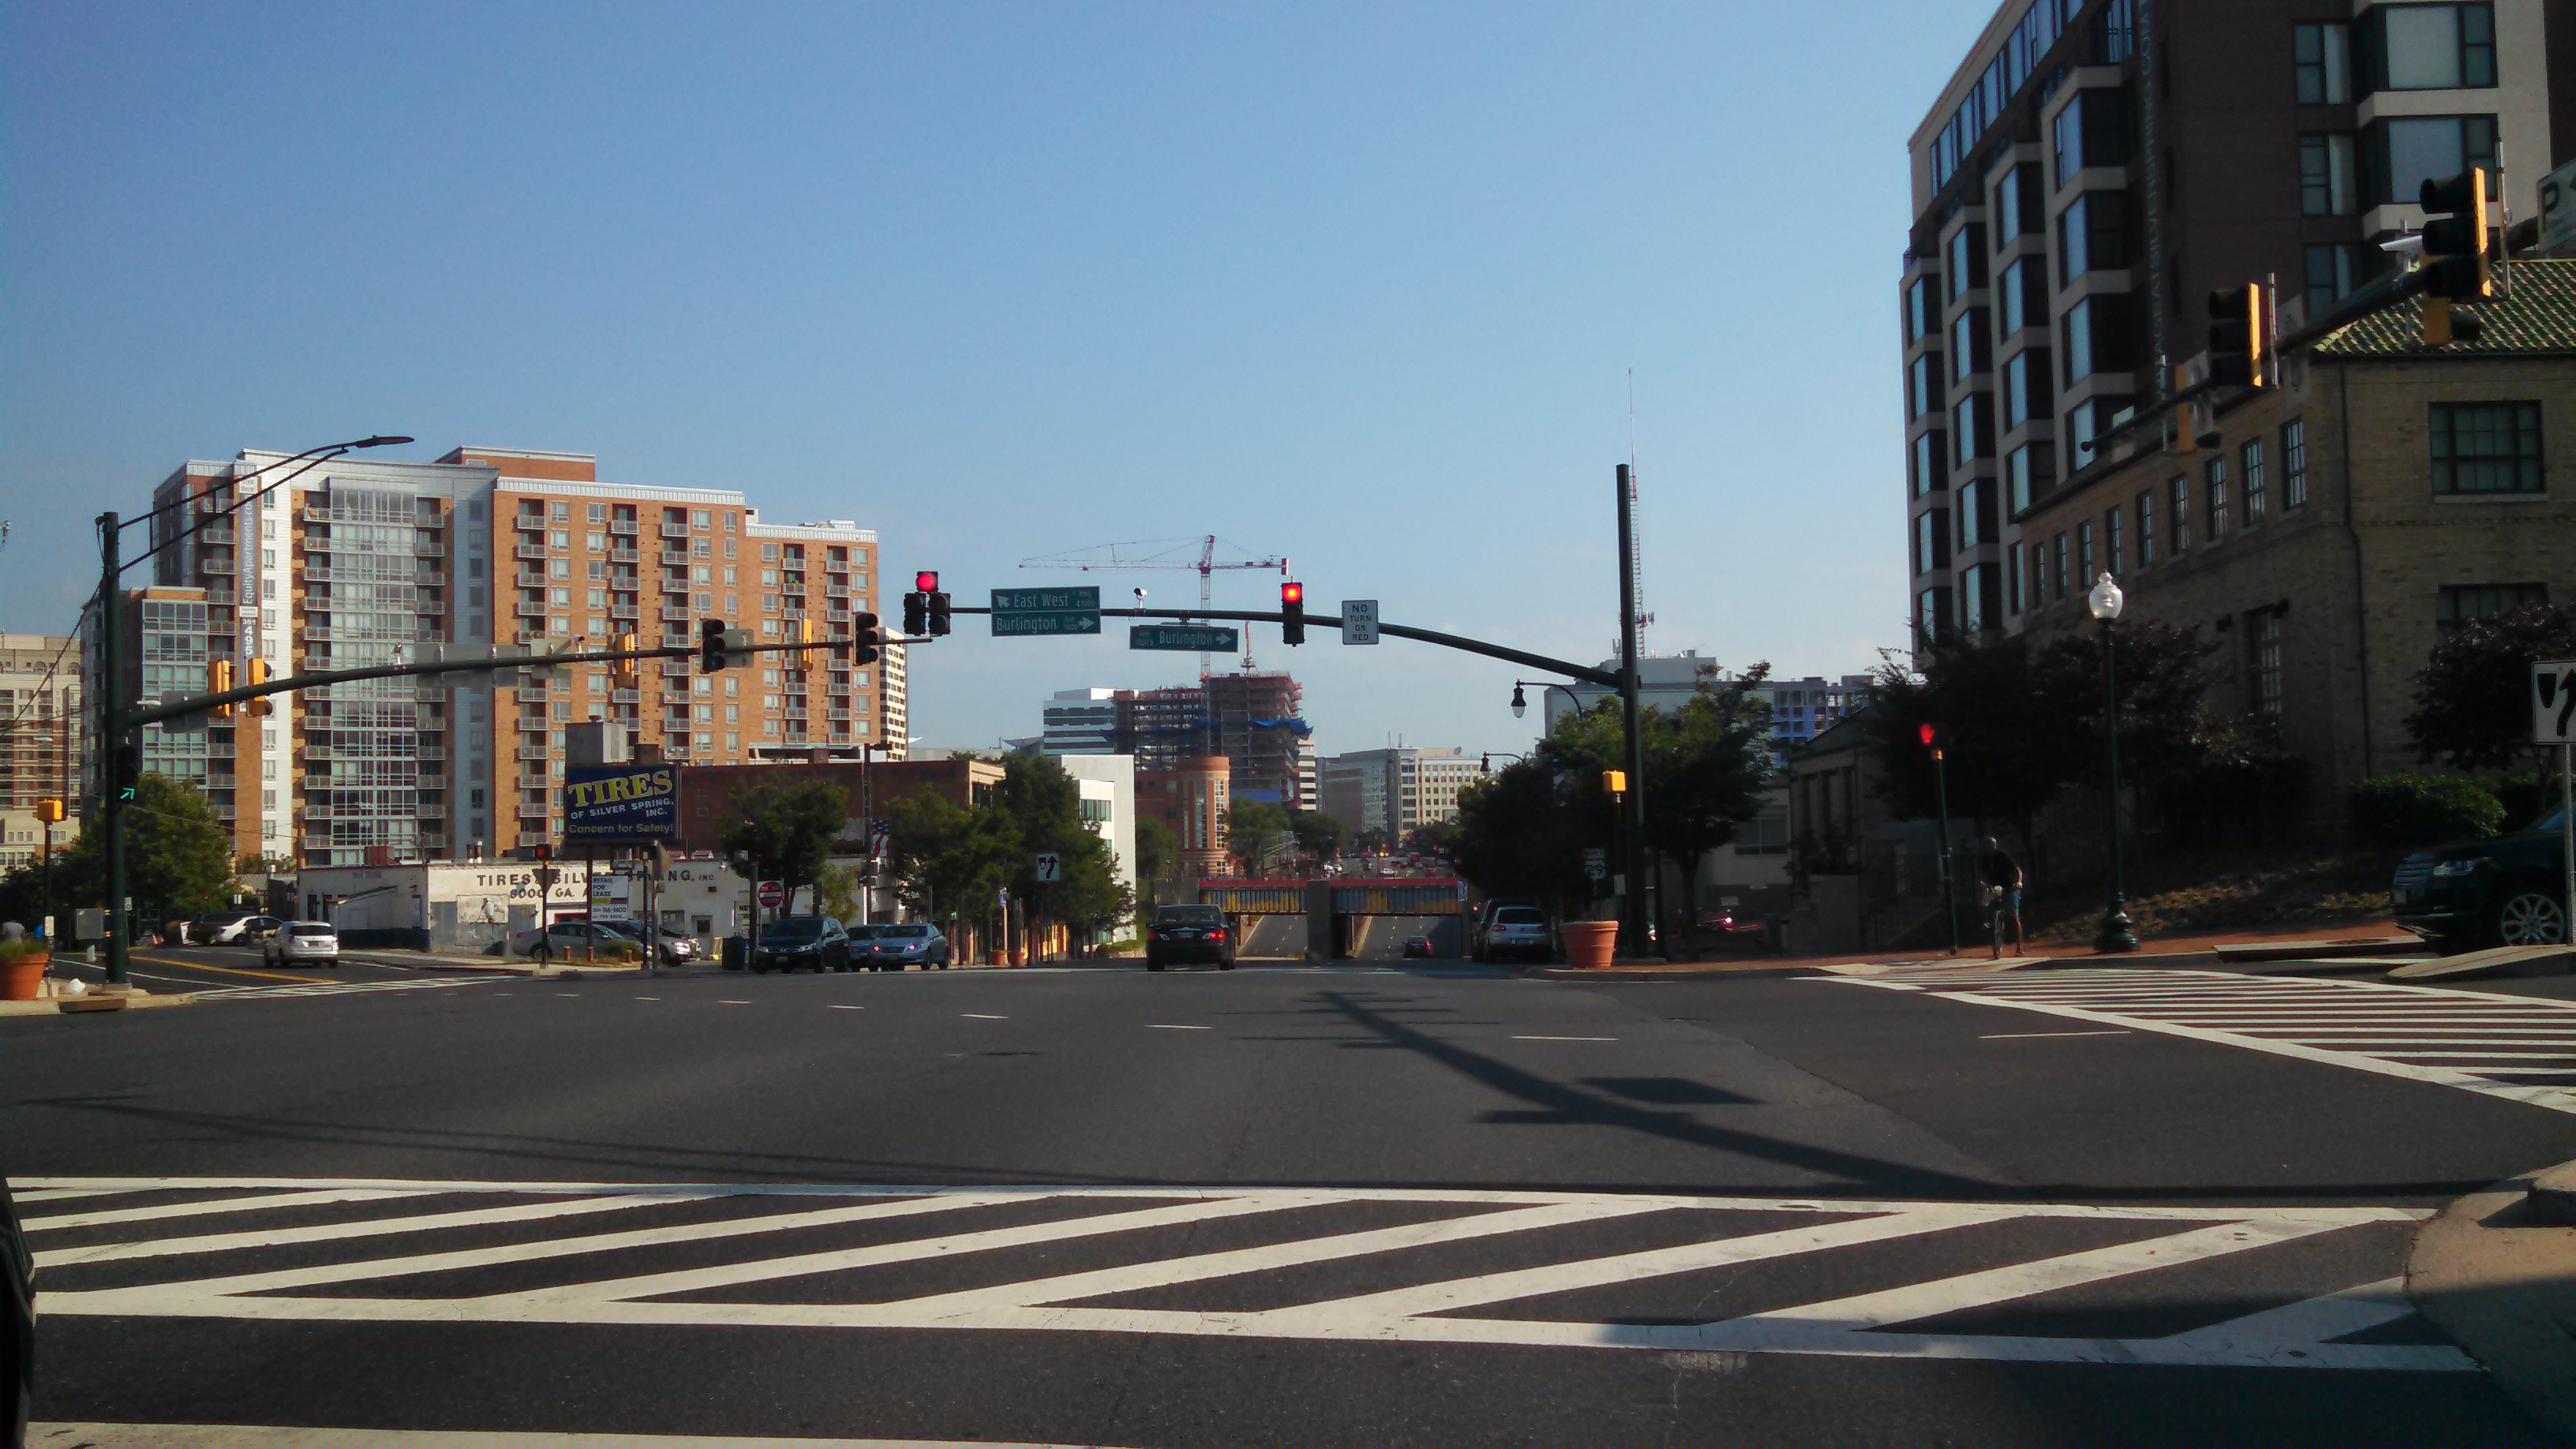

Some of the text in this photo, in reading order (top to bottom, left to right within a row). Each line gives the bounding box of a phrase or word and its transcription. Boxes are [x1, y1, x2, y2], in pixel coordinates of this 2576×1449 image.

[2541, 182, 2559, 233] P
[1014, 593, 1069, 608] East West
[1352, 604, 1368, 613] NO
[996, 616, 1057, 633] Burlington
[1159, 631, 1213, 648] Burlington
[567, 770, 672, 807] TIRES
[571, 798, 674, 820] OF SILVER SPRING,
[646, 807, 668, 818] INC.
[569, 824, 614, 833] Concern
[618, 824, 633, 833] for
[477, 874, 531, 886] TIRES
[555, 887, 575, 898] GA.
